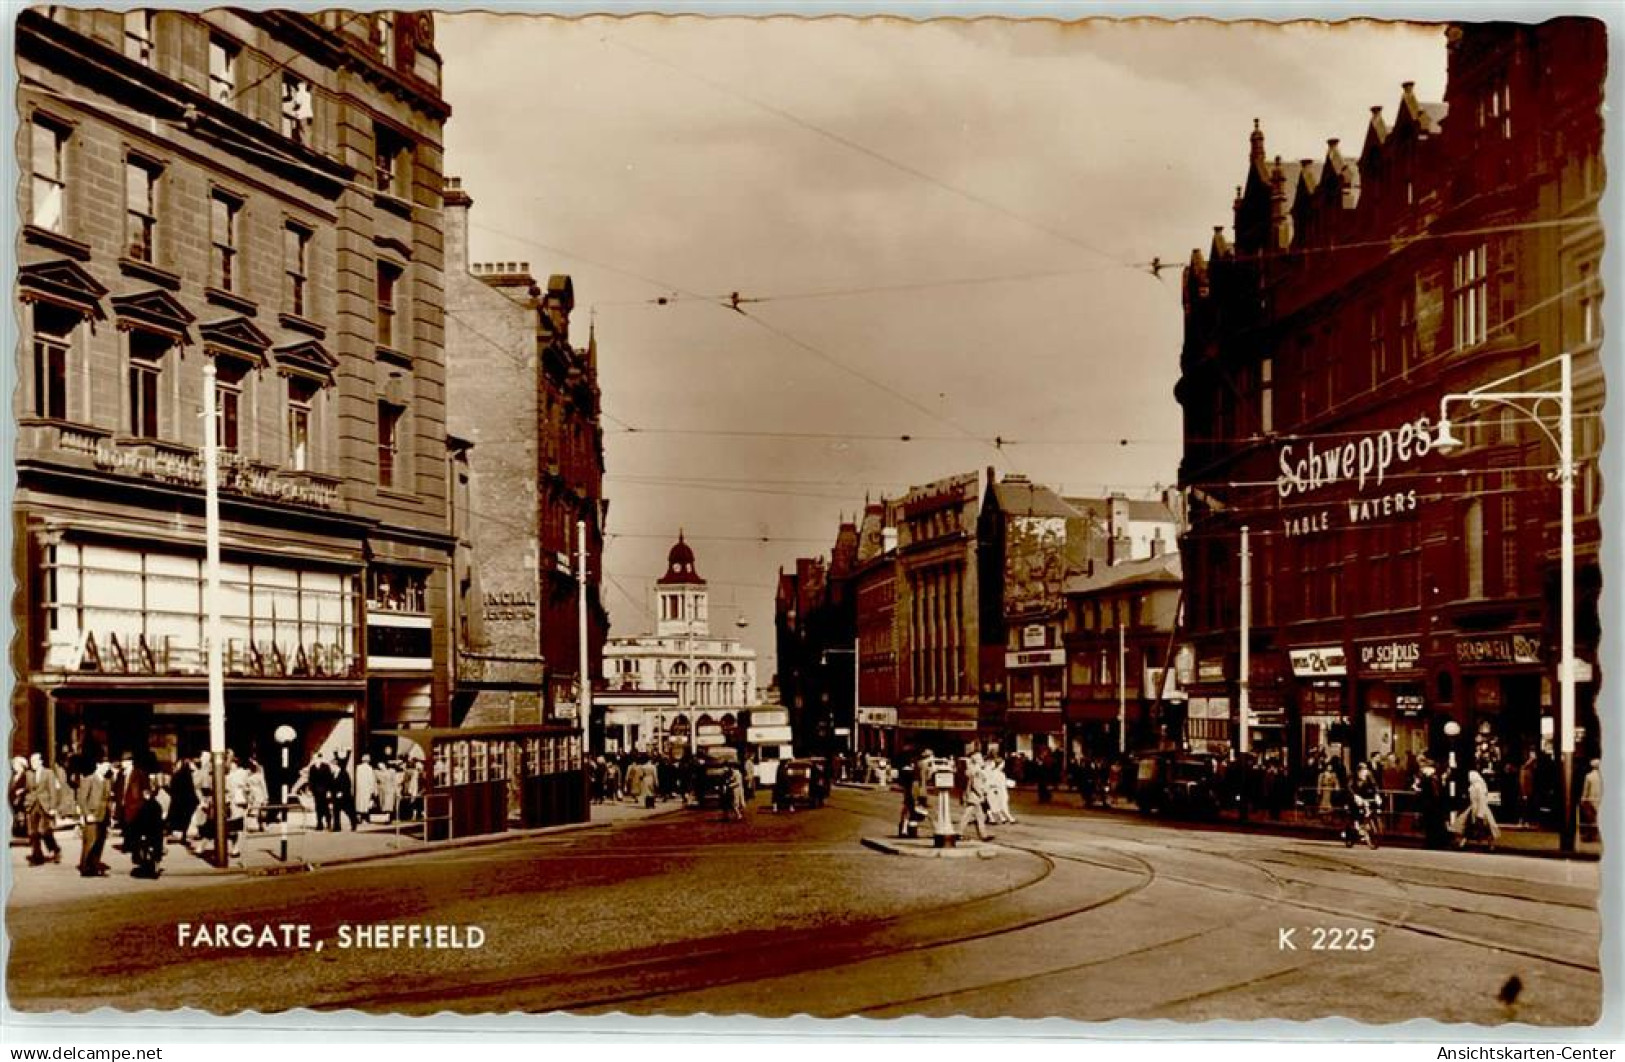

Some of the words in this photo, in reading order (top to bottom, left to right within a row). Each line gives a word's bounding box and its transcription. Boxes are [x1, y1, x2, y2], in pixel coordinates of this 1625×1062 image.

[1278, 417, 1431, 497] Schweppes
[1284, 511, 1329, 538] TABLE
[1349, 490, 1416, 522] WATERS
